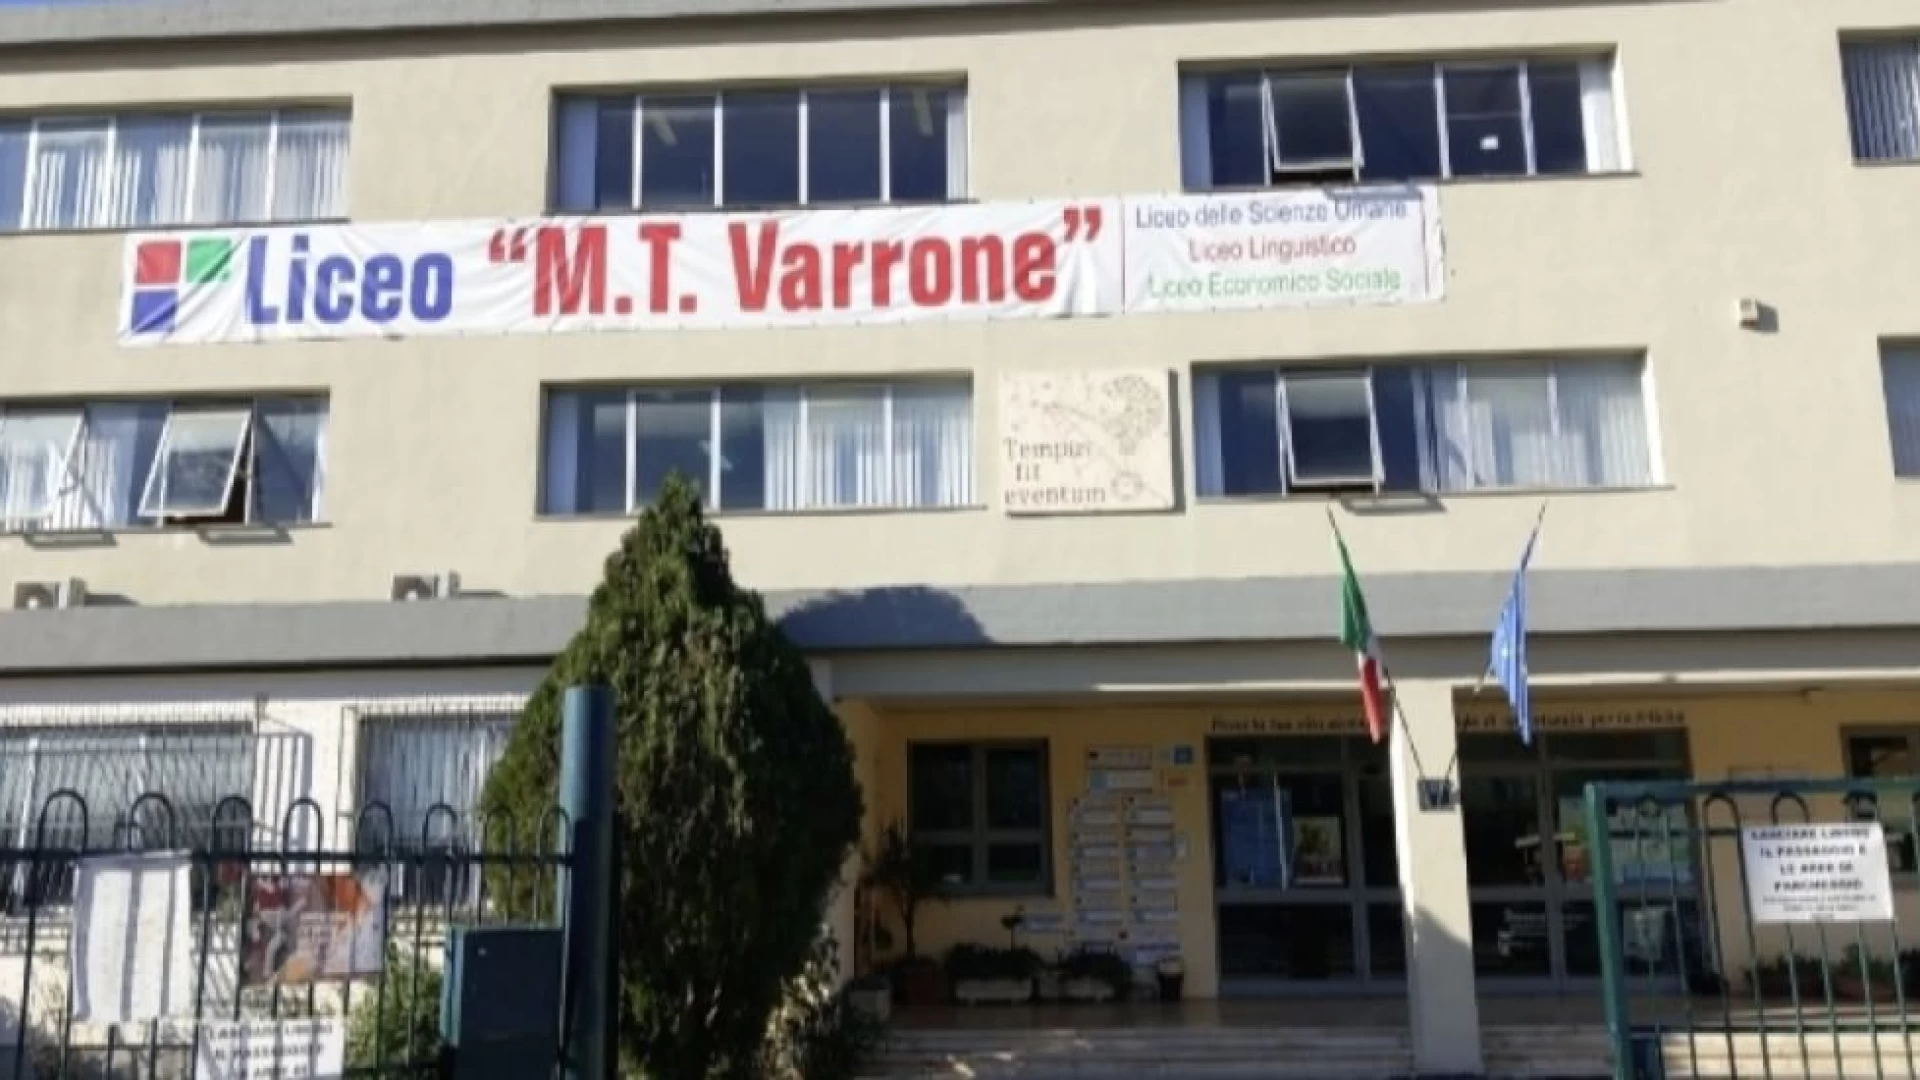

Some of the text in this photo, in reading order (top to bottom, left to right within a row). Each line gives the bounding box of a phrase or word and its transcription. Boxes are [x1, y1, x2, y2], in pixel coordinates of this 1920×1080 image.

[1136, 207, 1190, 229] Liceo
[1195, 204, 1243, 226] delle
[1250, 202, 1328, 225] Scienze
[1189, 234, 1356, 263] Liceo Linguistico
[246, 234, 453, 325] Liceo
[728, 206, 1102, 313] Varrone”
[1148, 267, 1401, 297] Liceo Economico Sociale
[1004, 486, 1106, 504] eventum
